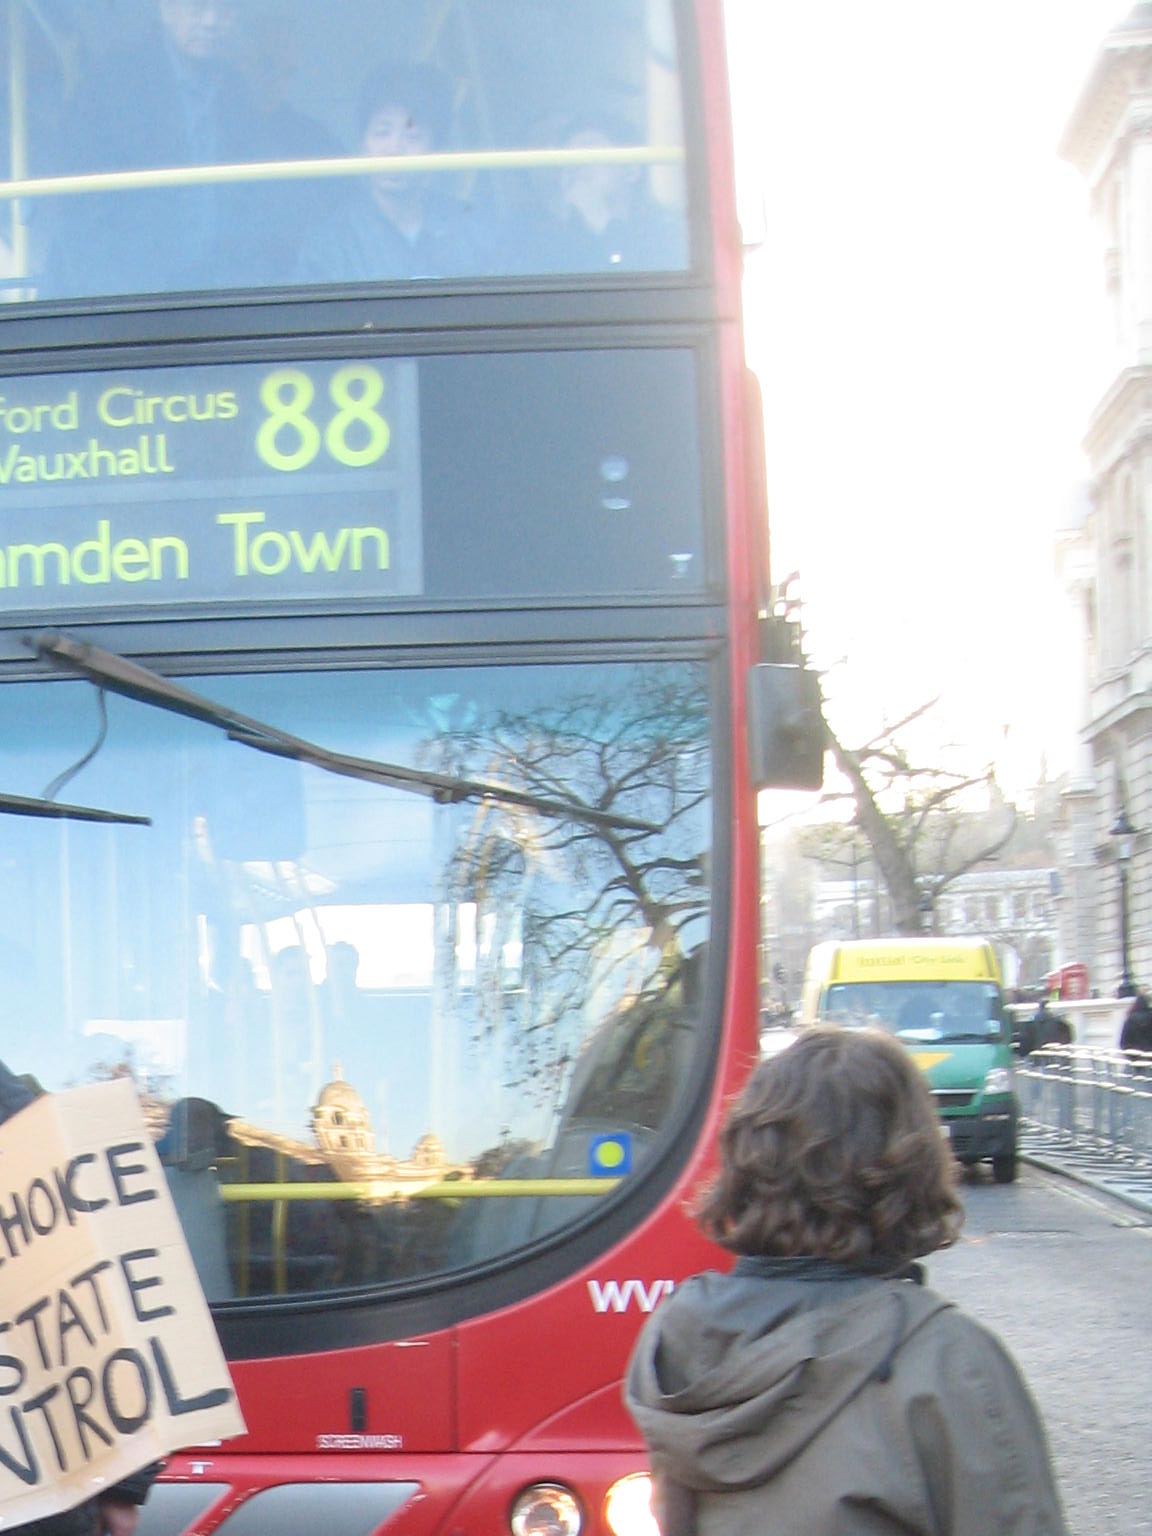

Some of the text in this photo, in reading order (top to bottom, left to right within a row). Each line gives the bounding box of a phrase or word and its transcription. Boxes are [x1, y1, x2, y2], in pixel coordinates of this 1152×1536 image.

[98, 386, 239, 429] Circus
[255, 364, 391, 471] 88
[216, 511, 390, 576] Town
